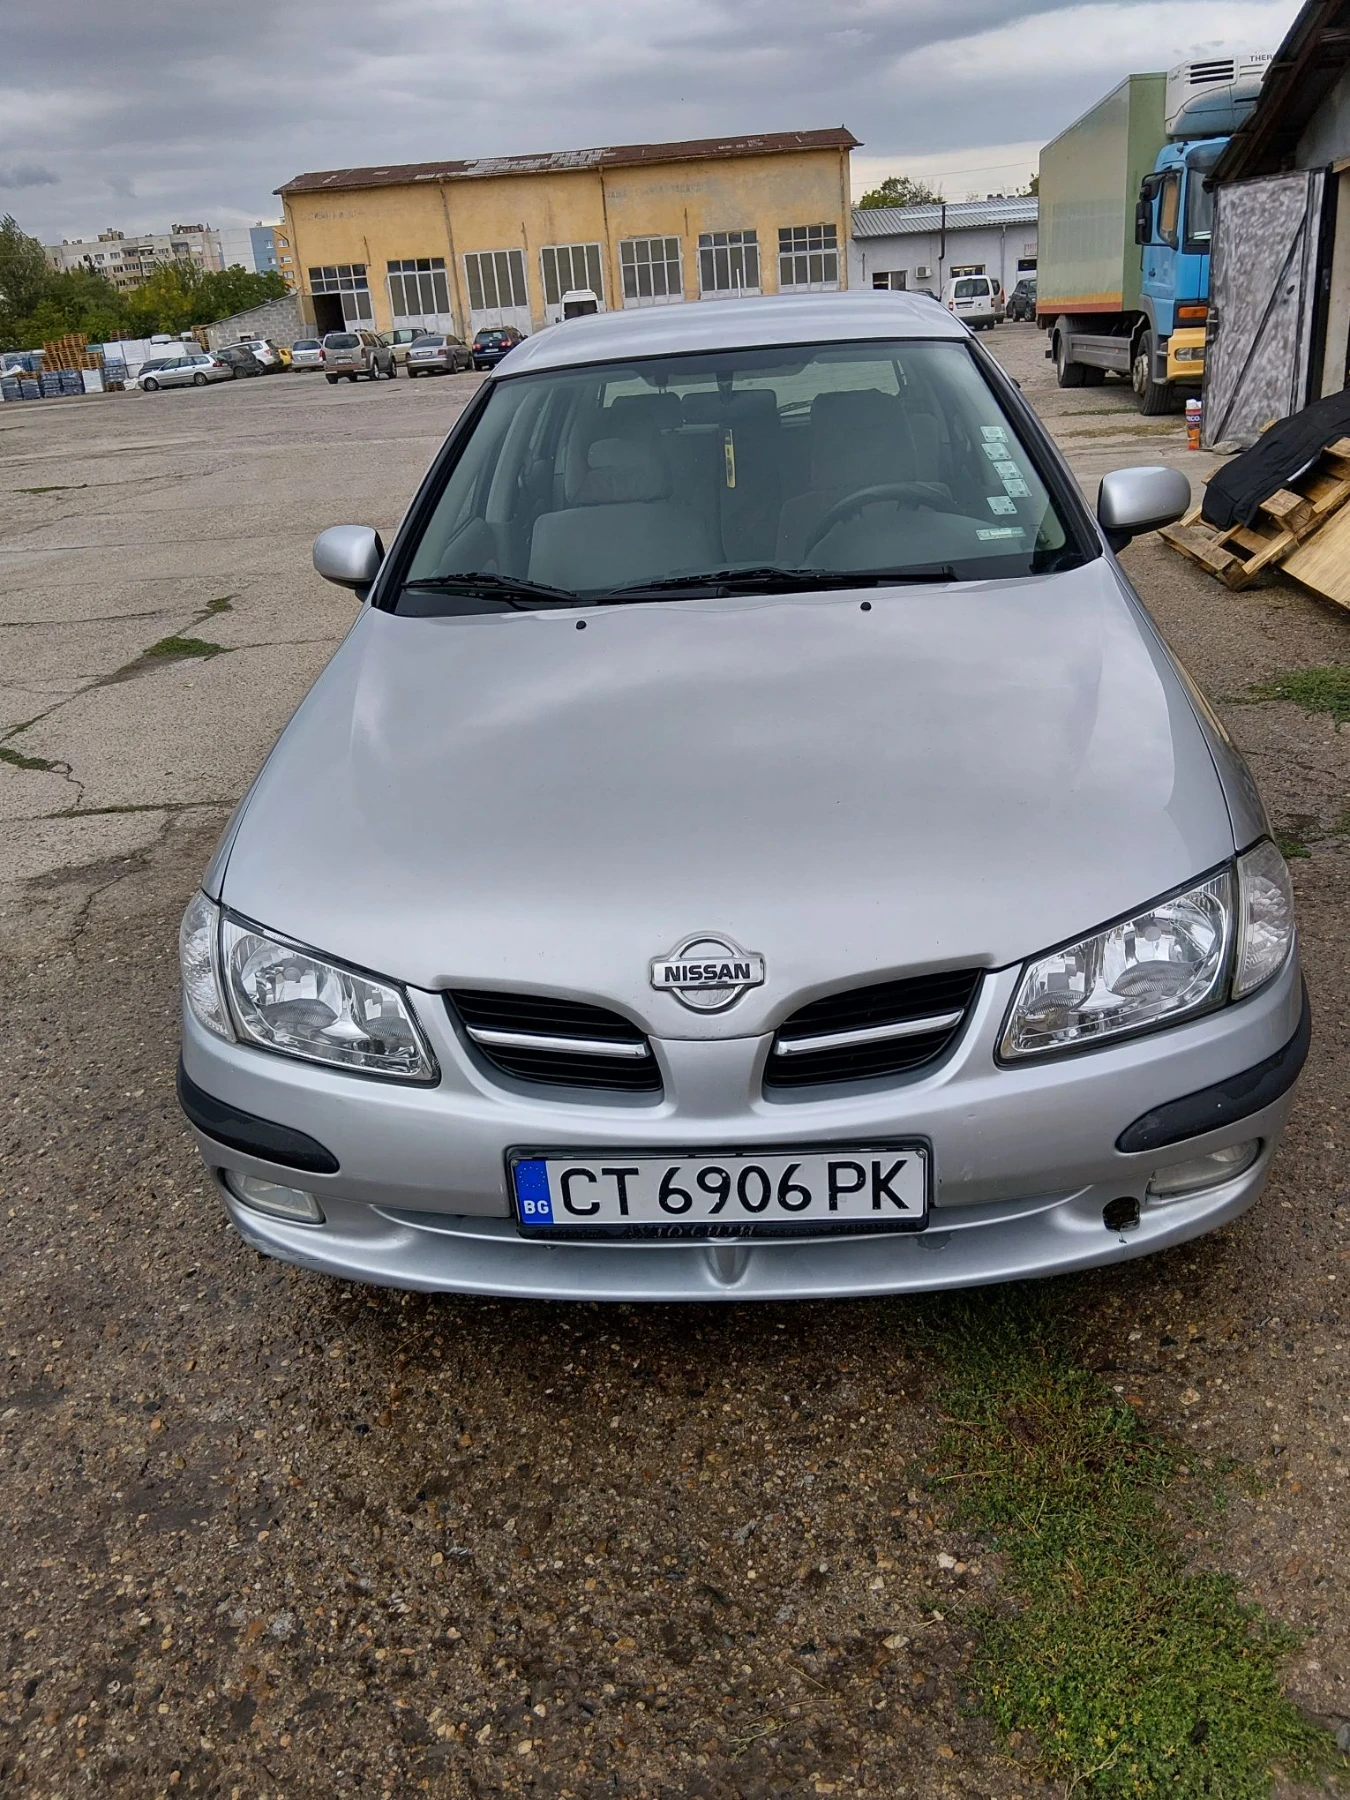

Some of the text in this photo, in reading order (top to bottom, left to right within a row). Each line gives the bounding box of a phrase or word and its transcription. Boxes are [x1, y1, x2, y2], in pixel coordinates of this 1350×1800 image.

[664, 963, 751, 982] NISSAN
[560, 1160, 908, 1216] CT 6906 PK
[524, 1200, 550, 1215] BG
